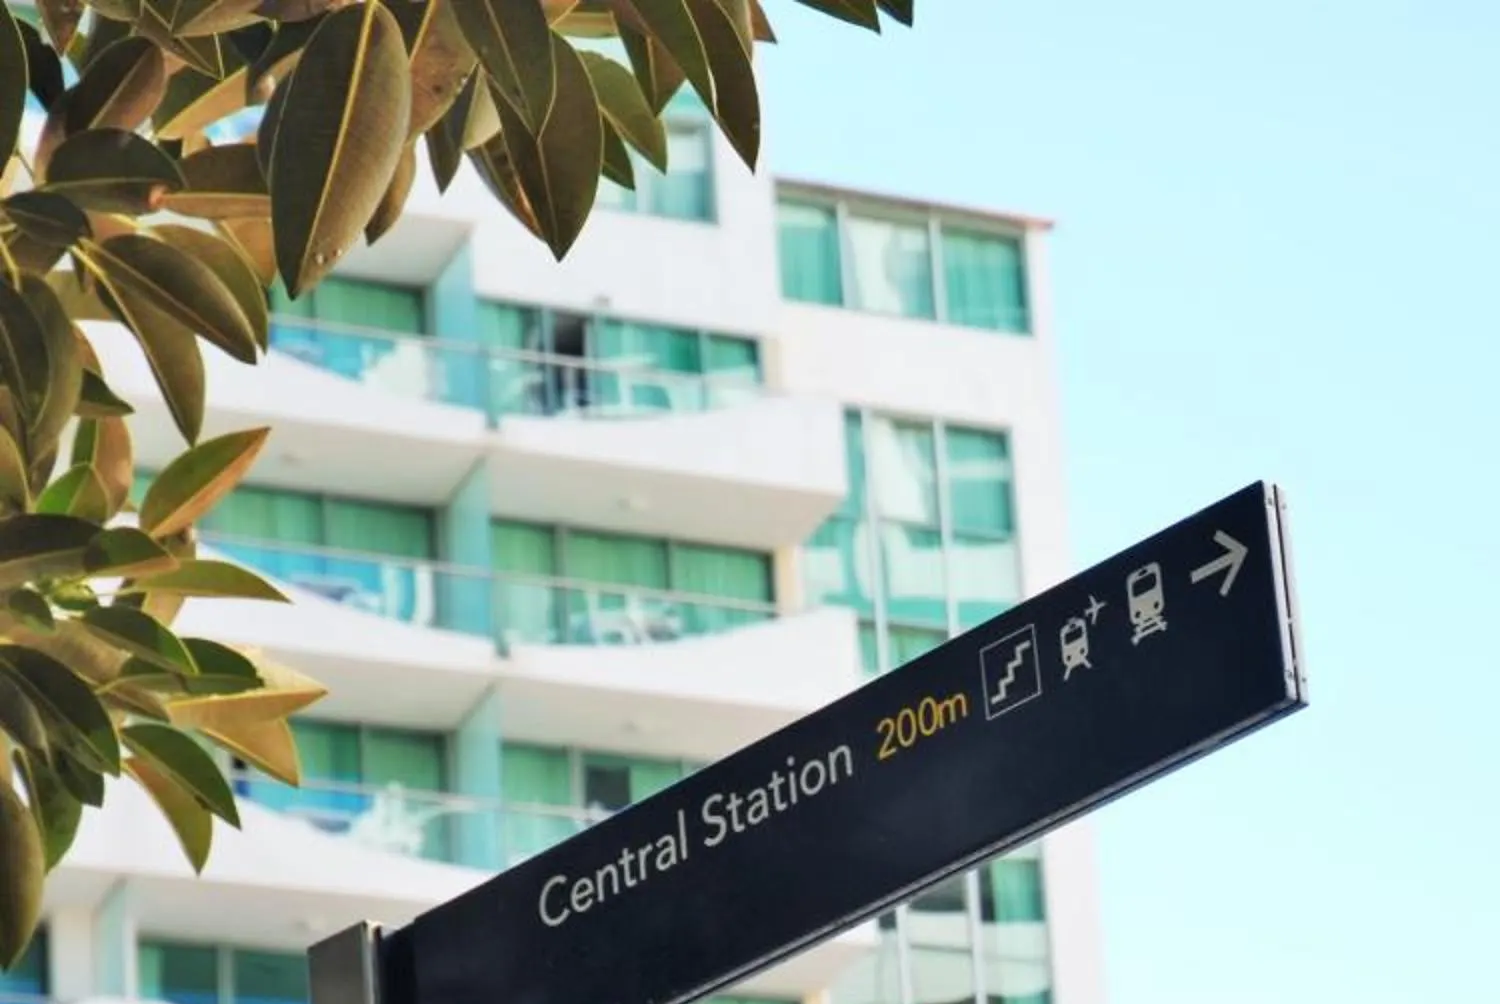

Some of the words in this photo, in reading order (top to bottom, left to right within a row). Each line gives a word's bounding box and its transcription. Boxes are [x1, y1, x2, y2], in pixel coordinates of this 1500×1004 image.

[539, 809, 688, 927] Central
[702, 743, 853, 847] Station
[876, 692, 968, 760] 200m
